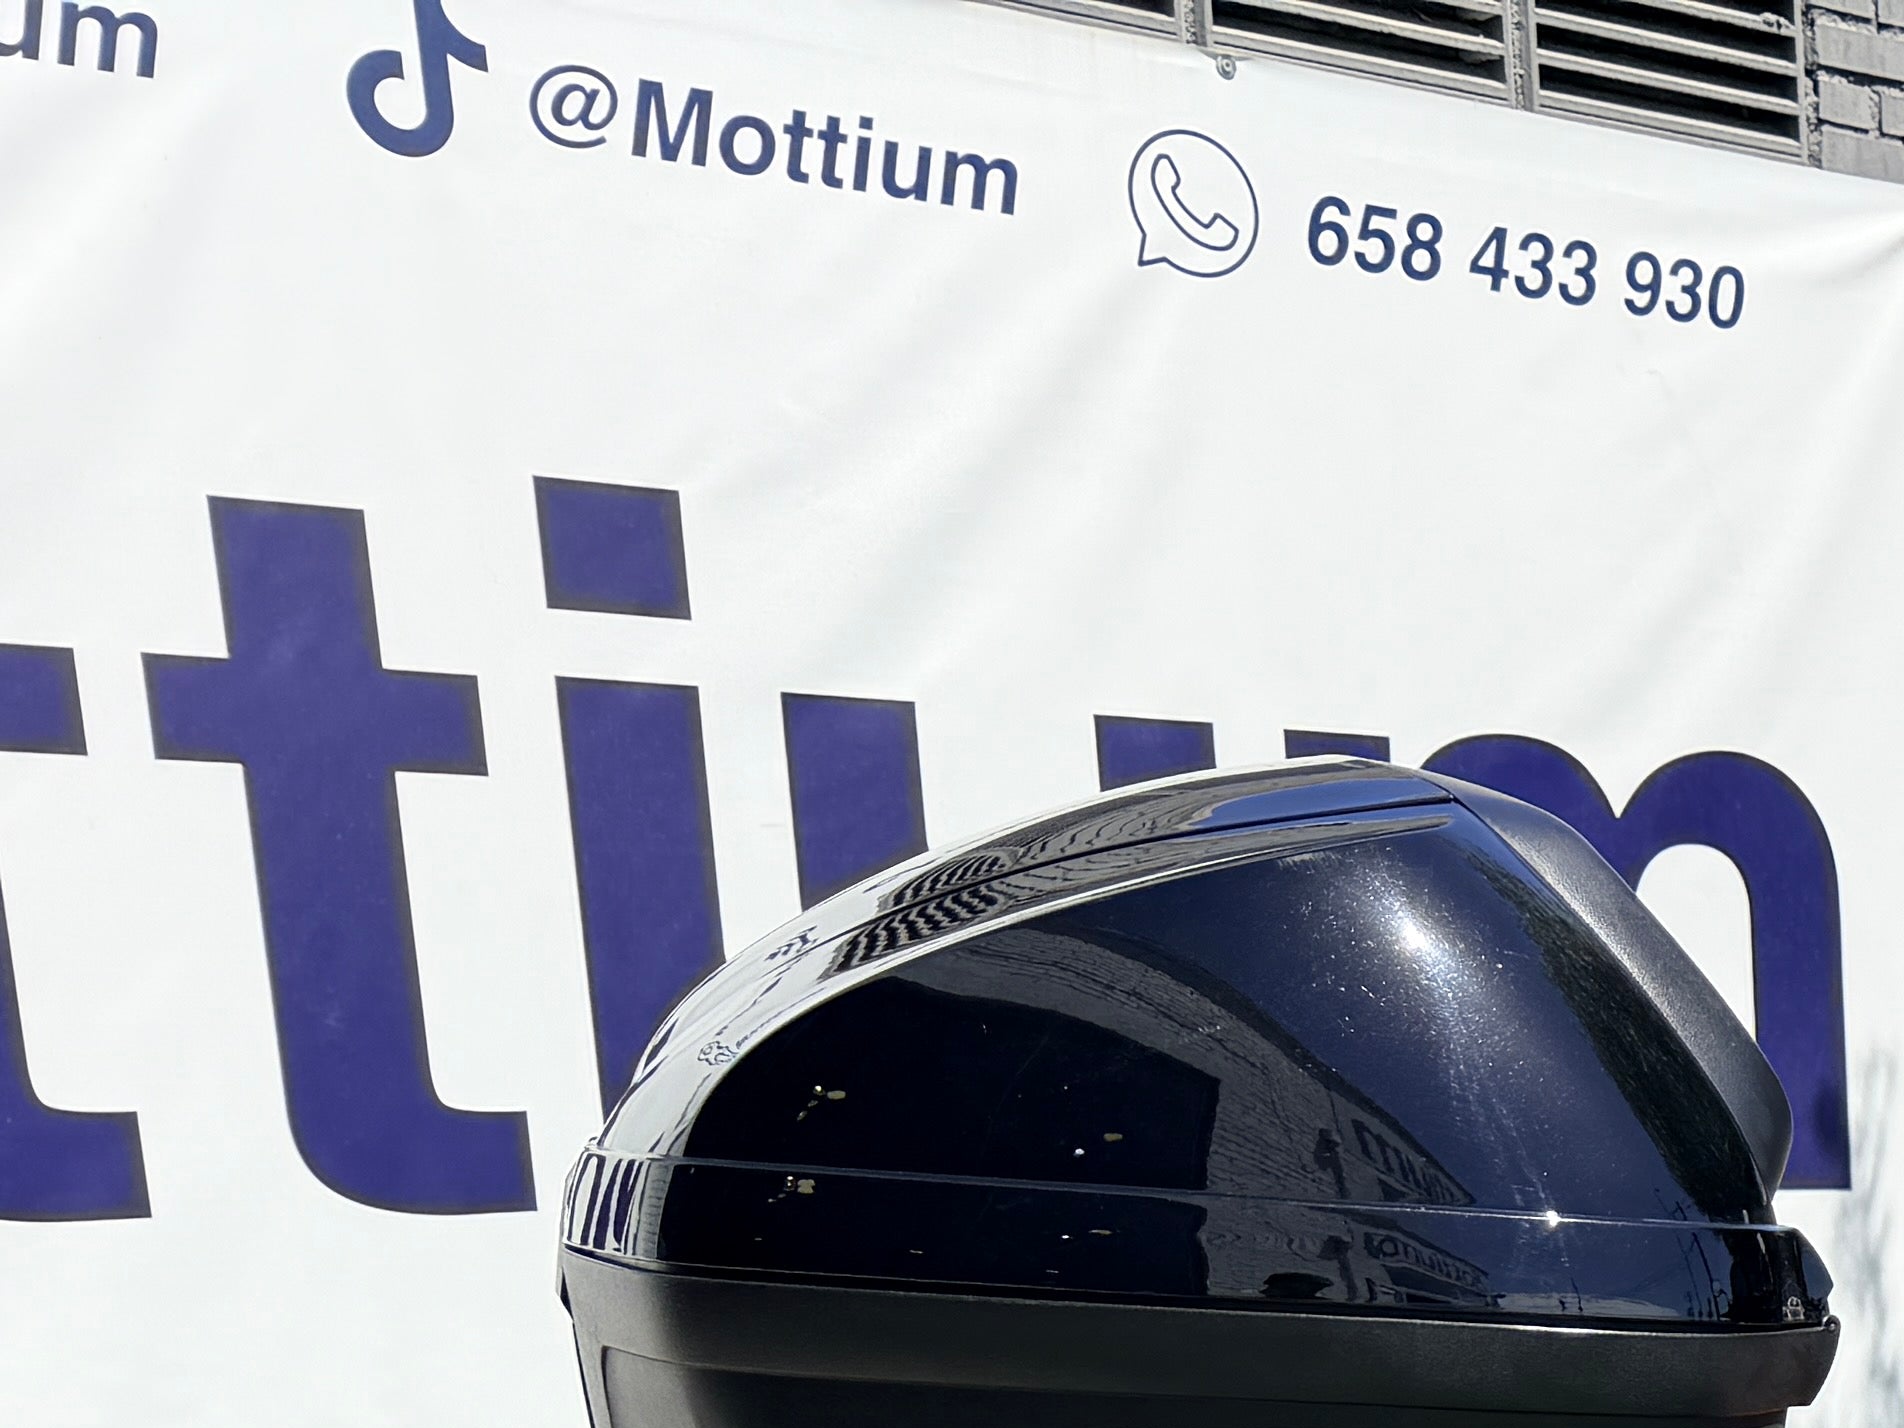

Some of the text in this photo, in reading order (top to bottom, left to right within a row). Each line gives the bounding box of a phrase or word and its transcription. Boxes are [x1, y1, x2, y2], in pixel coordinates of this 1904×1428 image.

[529, 64, 1019, 216] @Mottium
[1307, 195, 1746, 330] 658 433 930
